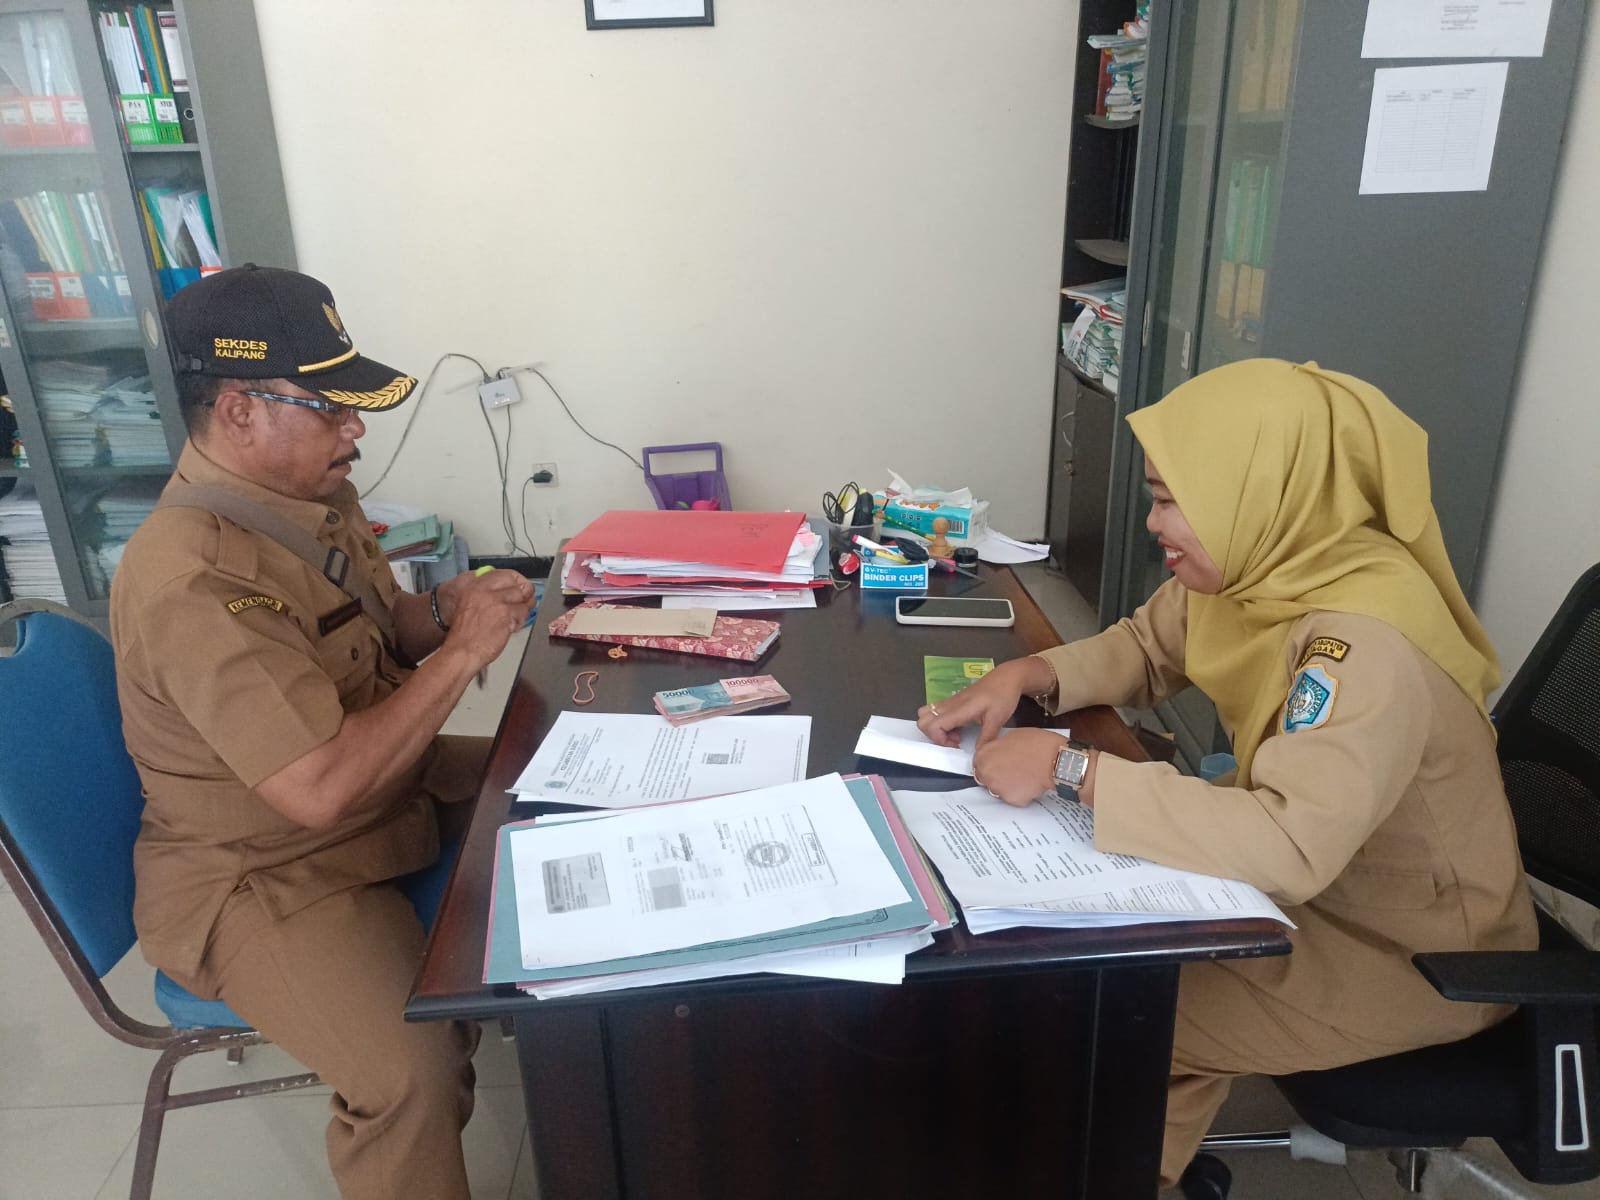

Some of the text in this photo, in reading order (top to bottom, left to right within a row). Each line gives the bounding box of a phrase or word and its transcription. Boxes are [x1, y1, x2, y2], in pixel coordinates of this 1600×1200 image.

[214, 338, 268, 350] SEKDES
[215, 348, 266, 360] KALIPANG
[864, 573, 925, 582] BINDER CLIPS
[662, 688, 695, 698] 50000
